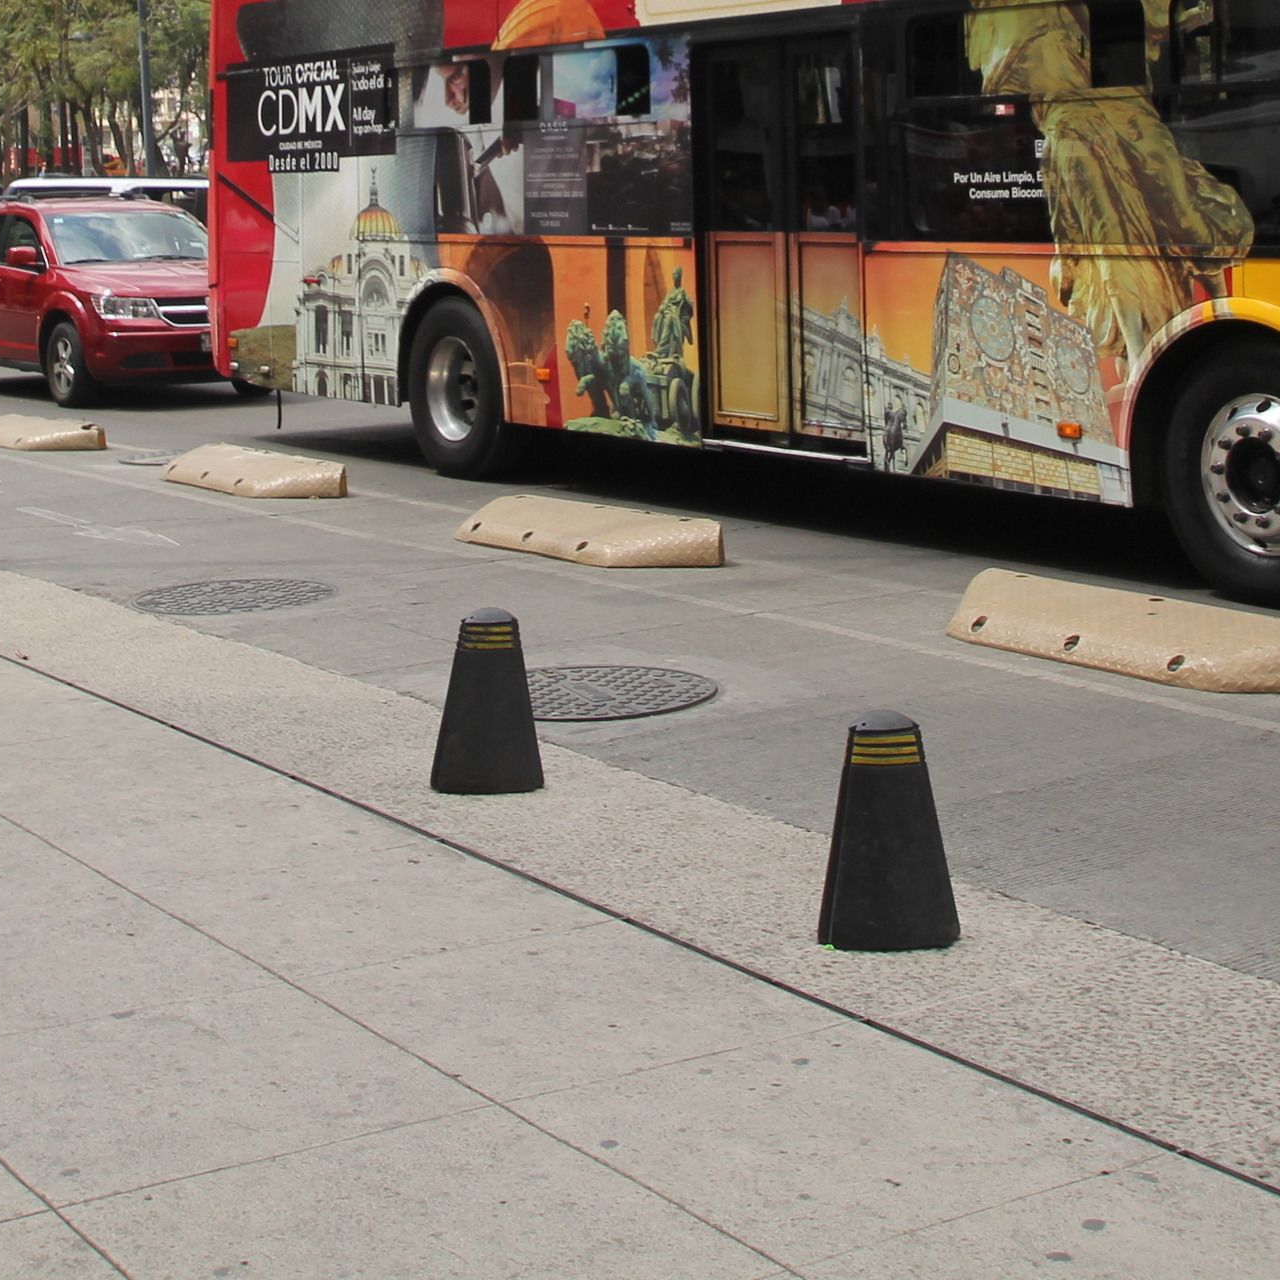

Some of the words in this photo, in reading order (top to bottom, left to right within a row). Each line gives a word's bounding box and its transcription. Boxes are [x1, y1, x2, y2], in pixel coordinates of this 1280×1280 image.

[262, 66, 293, 88] TOUR
[294, 60, 340, 84] OFICIAL
[369, 74, 376, 90] el
[257, 84, 346, 136] CDMX
[352, 106, 362, 121] All
[362, 105, 376, 126] day
[269, 153, 296, 171] Desde
[300, 152, 310, 170] el
[314, 151, 338, 170] 2000
[953, 172, 969, 183] Por
[970, 172, 982, 183] Un
[983, 171, 1001, 182] Aire
[1002, 171, 1035, 184] Limpio,
[969, 188, 1010, 199] Consume
